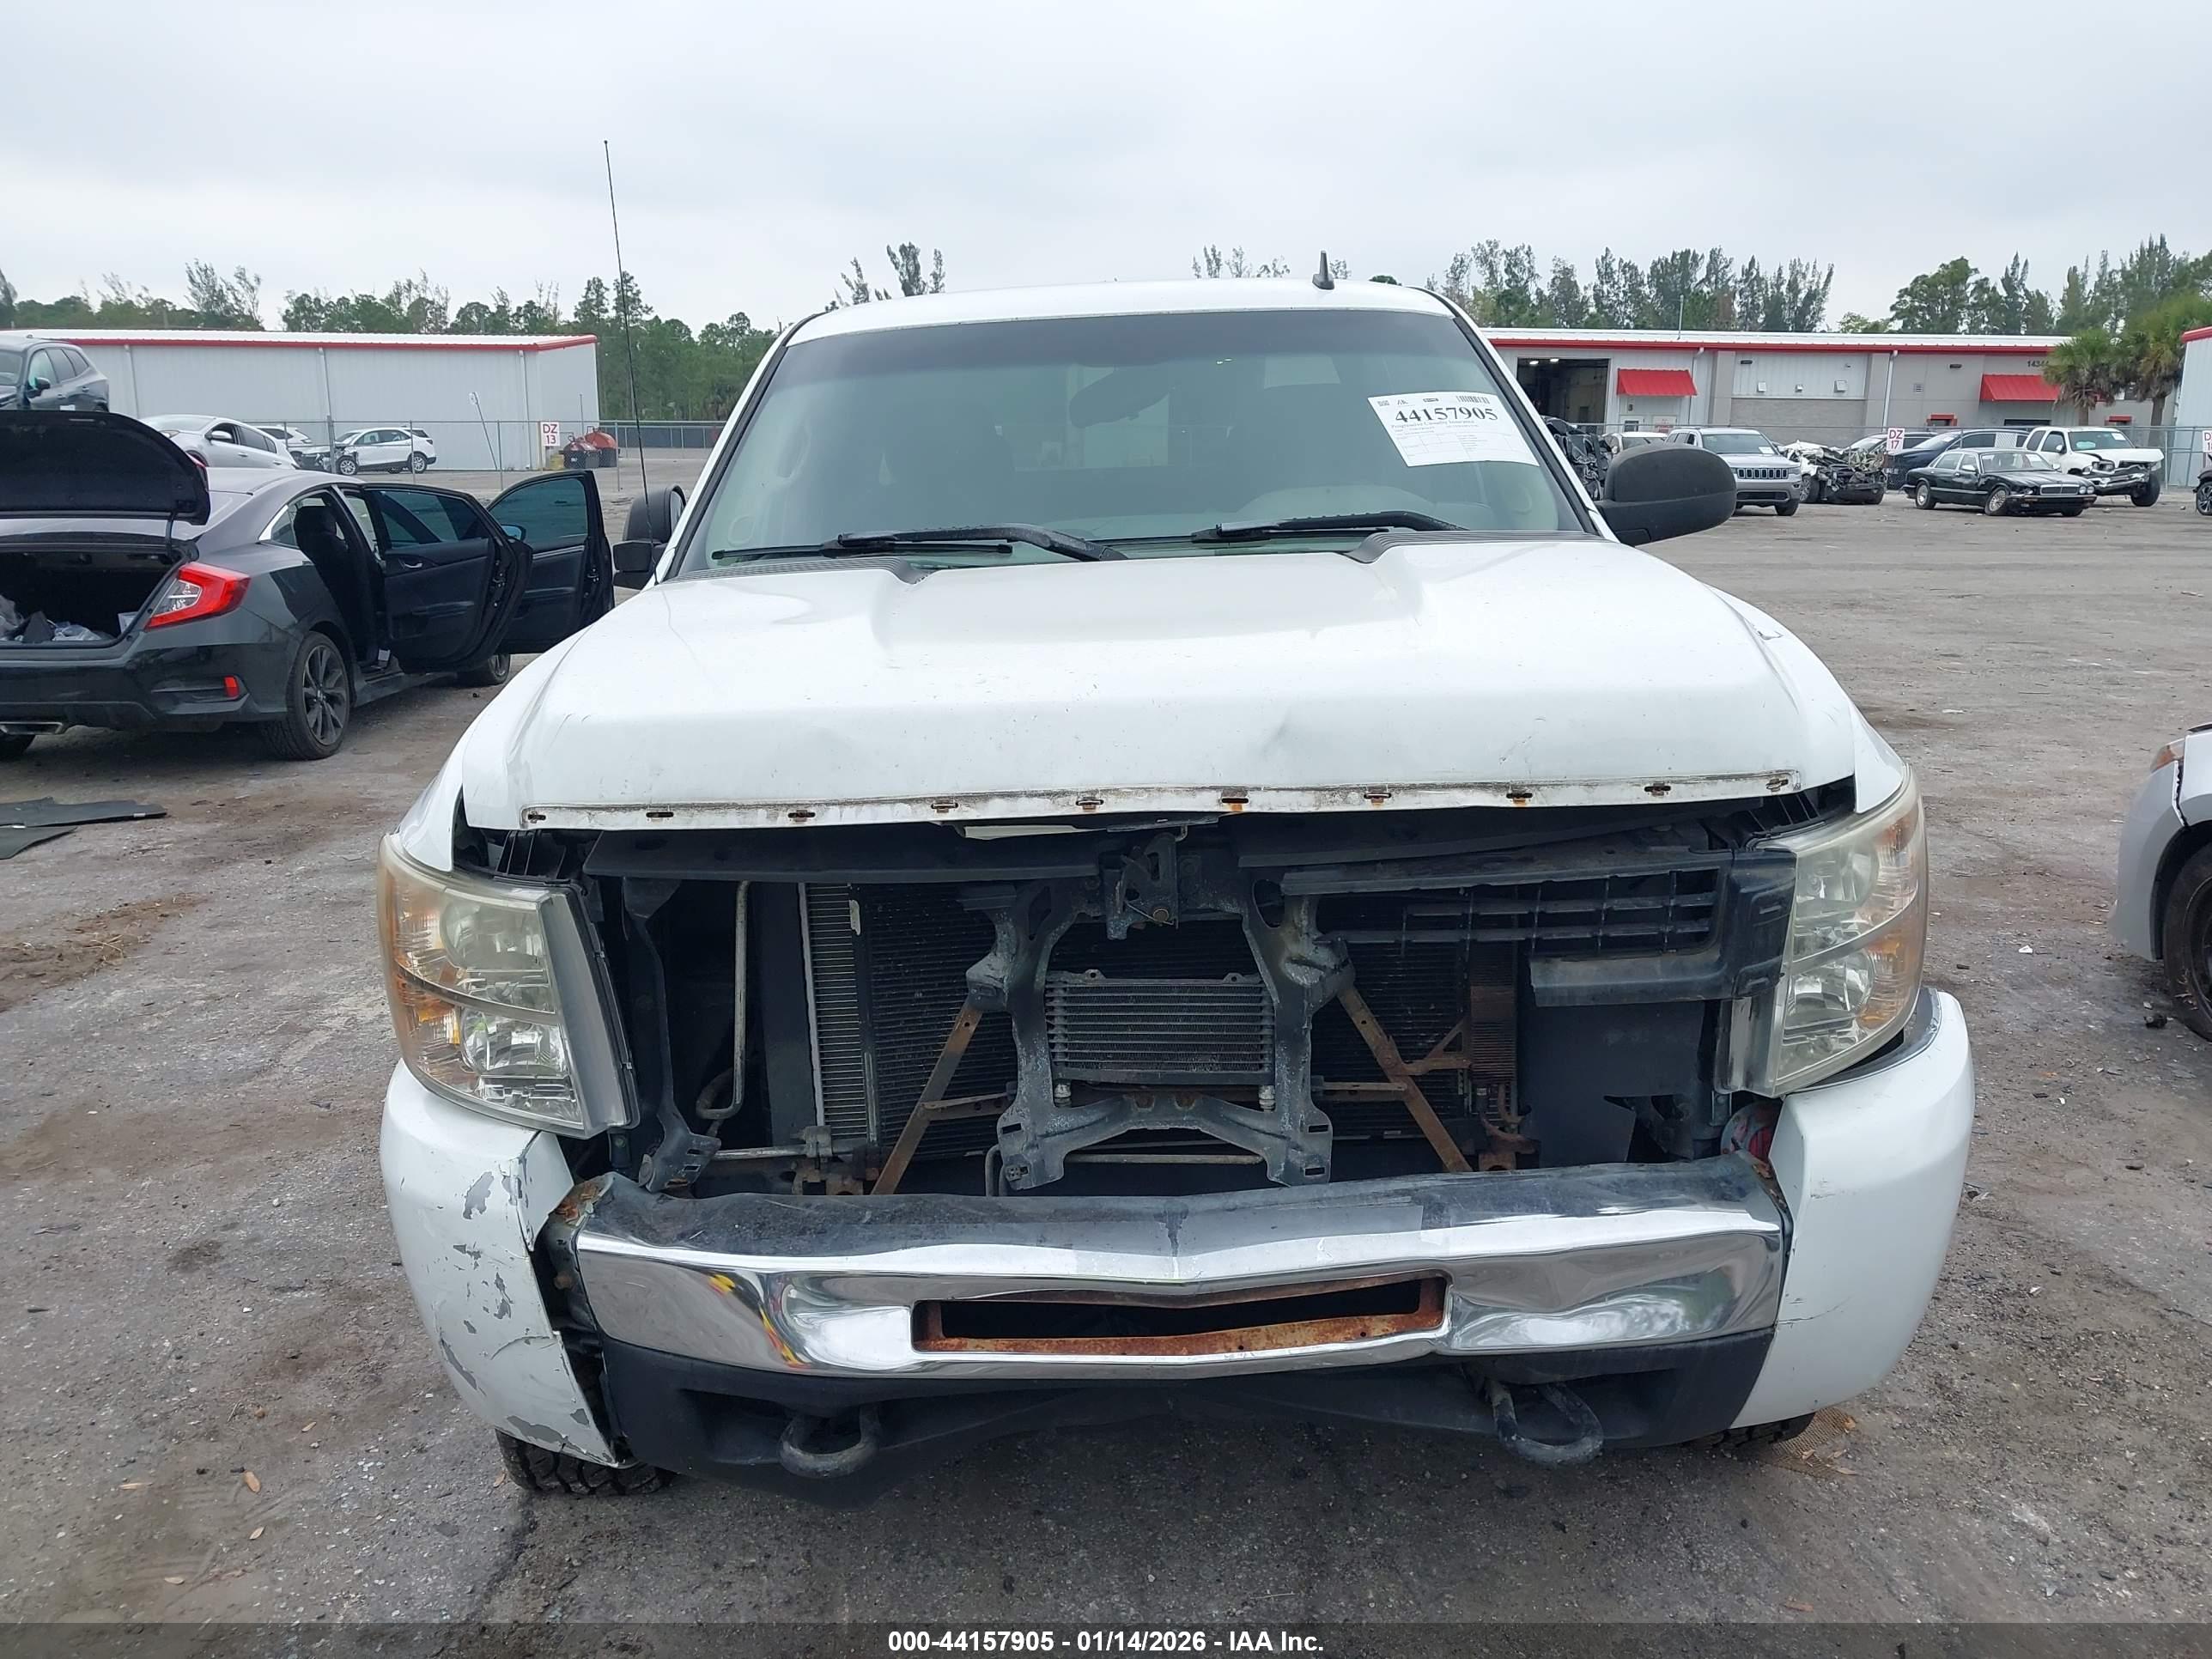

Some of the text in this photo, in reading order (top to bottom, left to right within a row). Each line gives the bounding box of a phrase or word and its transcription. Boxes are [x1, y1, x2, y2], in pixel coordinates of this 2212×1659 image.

[1395, 407, 1498, 422] 44157905
[543, 423, 558, 434] DZ
[546, 434, 556, 444] 13
[1889, 429, 1904, 439] DZ
[2204, 432, 2212, 441] D
[1891, 440, 1900, 449] 17
